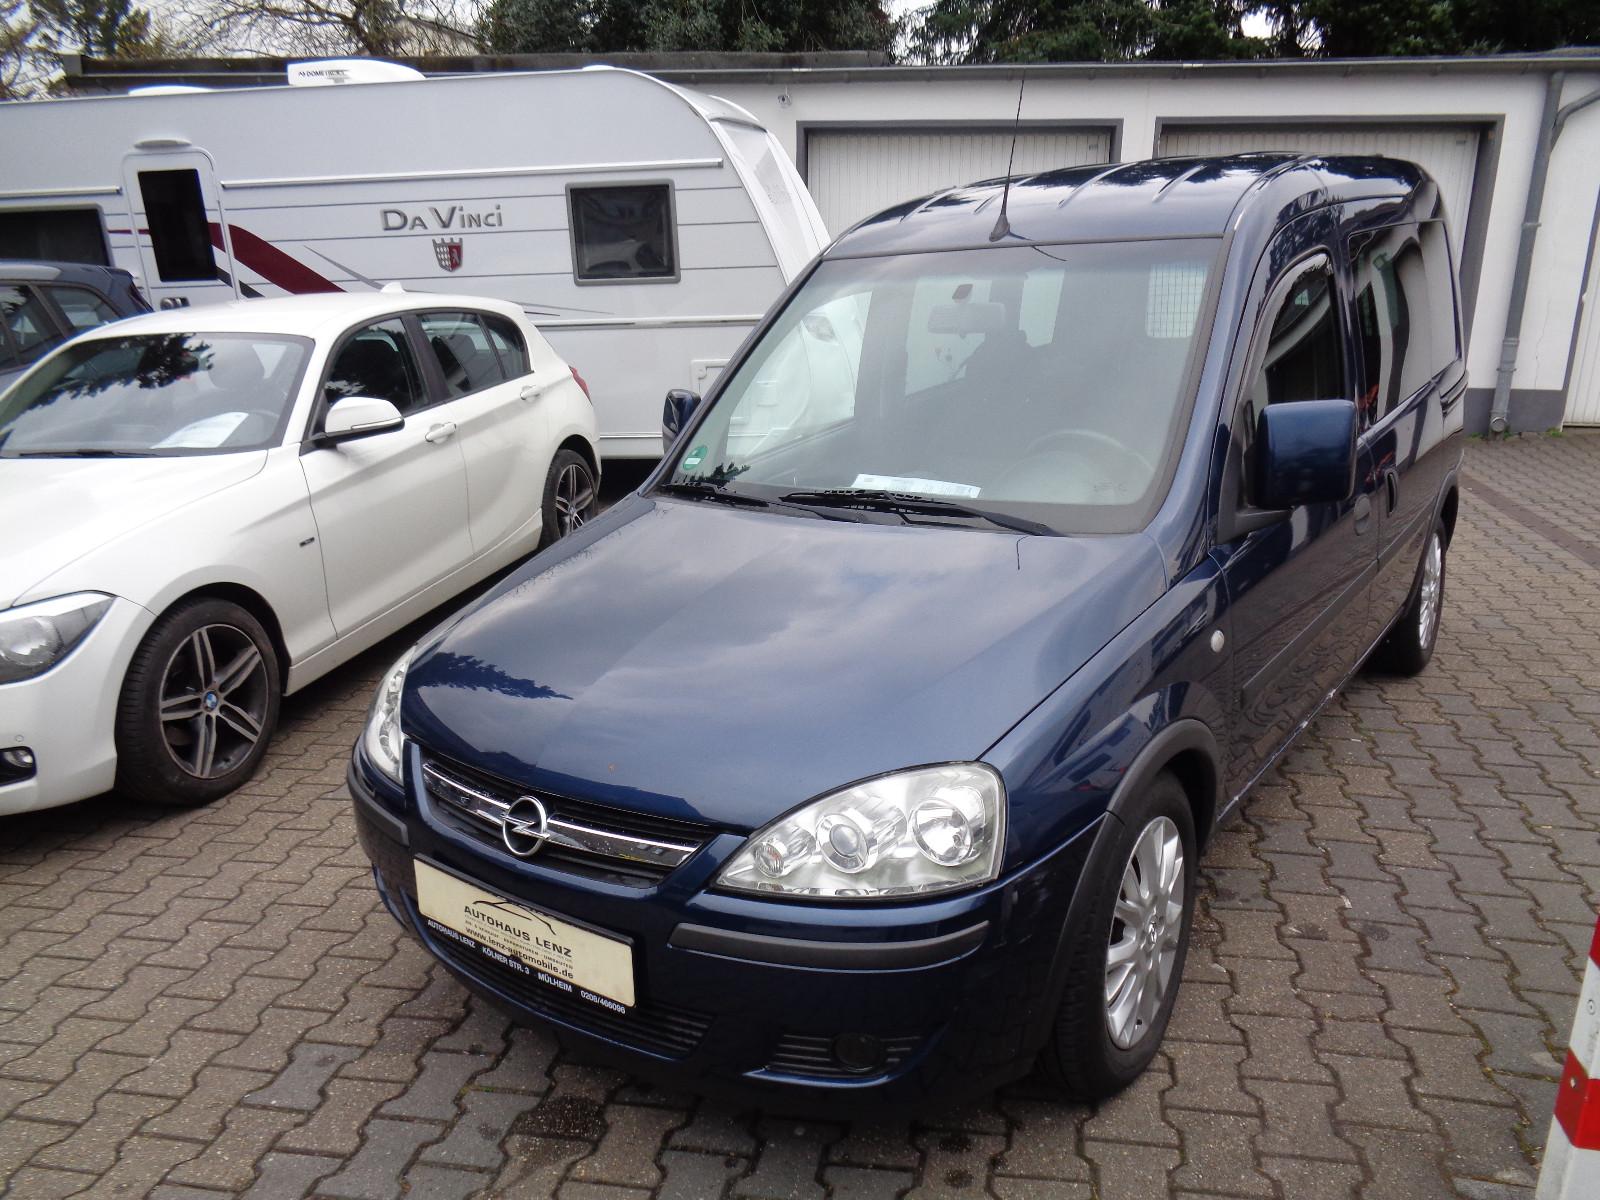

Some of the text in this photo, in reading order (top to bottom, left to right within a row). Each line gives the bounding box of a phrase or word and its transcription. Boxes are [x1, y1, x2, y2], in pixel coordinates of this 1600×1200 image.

[427, 919, 460, 940] AUTOHAUS
[459, 934, 476, 949] LENZ
[537, 971, 573, 993] MÜLHEIM
[464, 905, 531, 941] AUTOHAUS
[535, 936, 572, 958] LENZ
[464, 926, 574, 979] www.lenz-automobile.de
